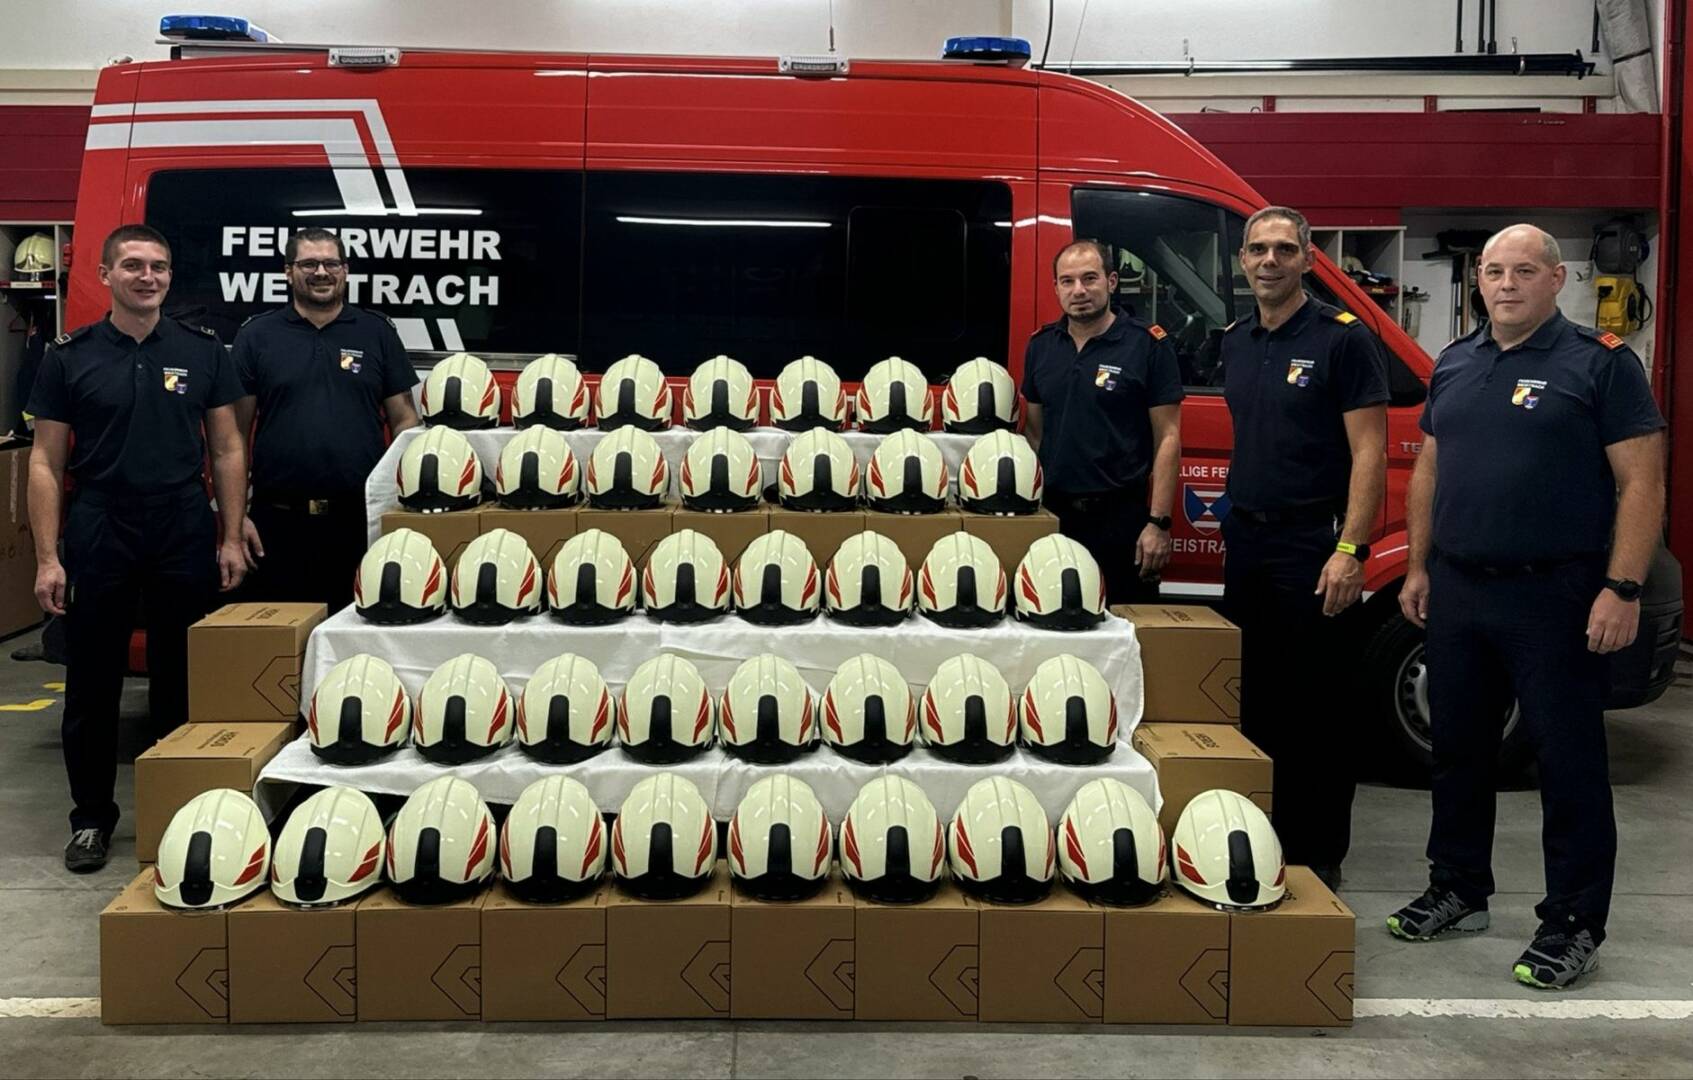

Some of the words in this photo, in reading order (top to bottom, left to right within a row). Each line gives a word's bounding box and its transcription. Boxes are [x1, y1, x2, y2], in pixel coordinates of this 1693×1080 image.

[221, 226, 502, 260] FERWEHR
[218, 271, 499, 305] WETRACH
[1179, 465, 1209, 478] LIGE
[1169, 538, 1226, 554] EISTRA
